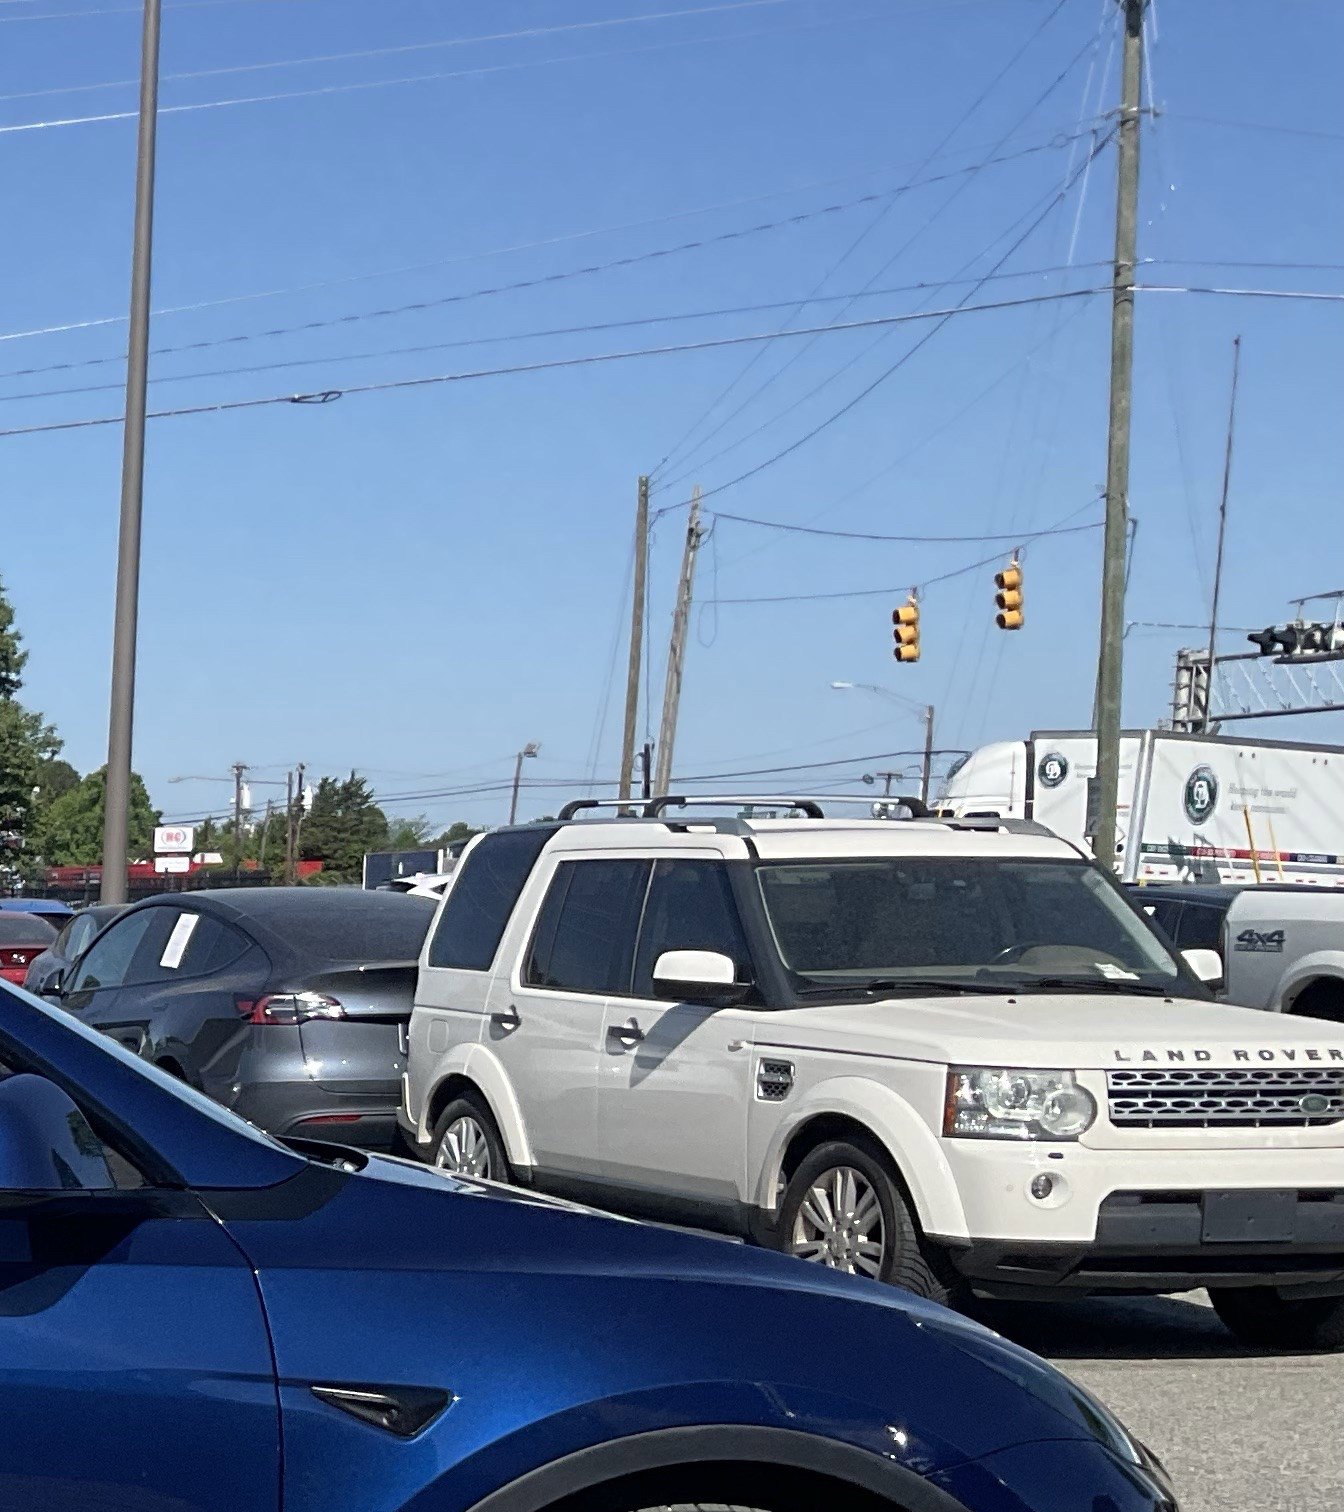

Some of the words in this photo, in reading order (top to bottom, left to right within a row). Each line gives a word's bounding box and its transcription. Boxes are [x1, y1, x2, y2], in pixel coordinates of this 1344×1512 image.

[1236, 929, 1286, 947] 4x4
[1114, 1050, 1212, 1062] LAND
[1233, 1049, 1344, 1062] ROVER
